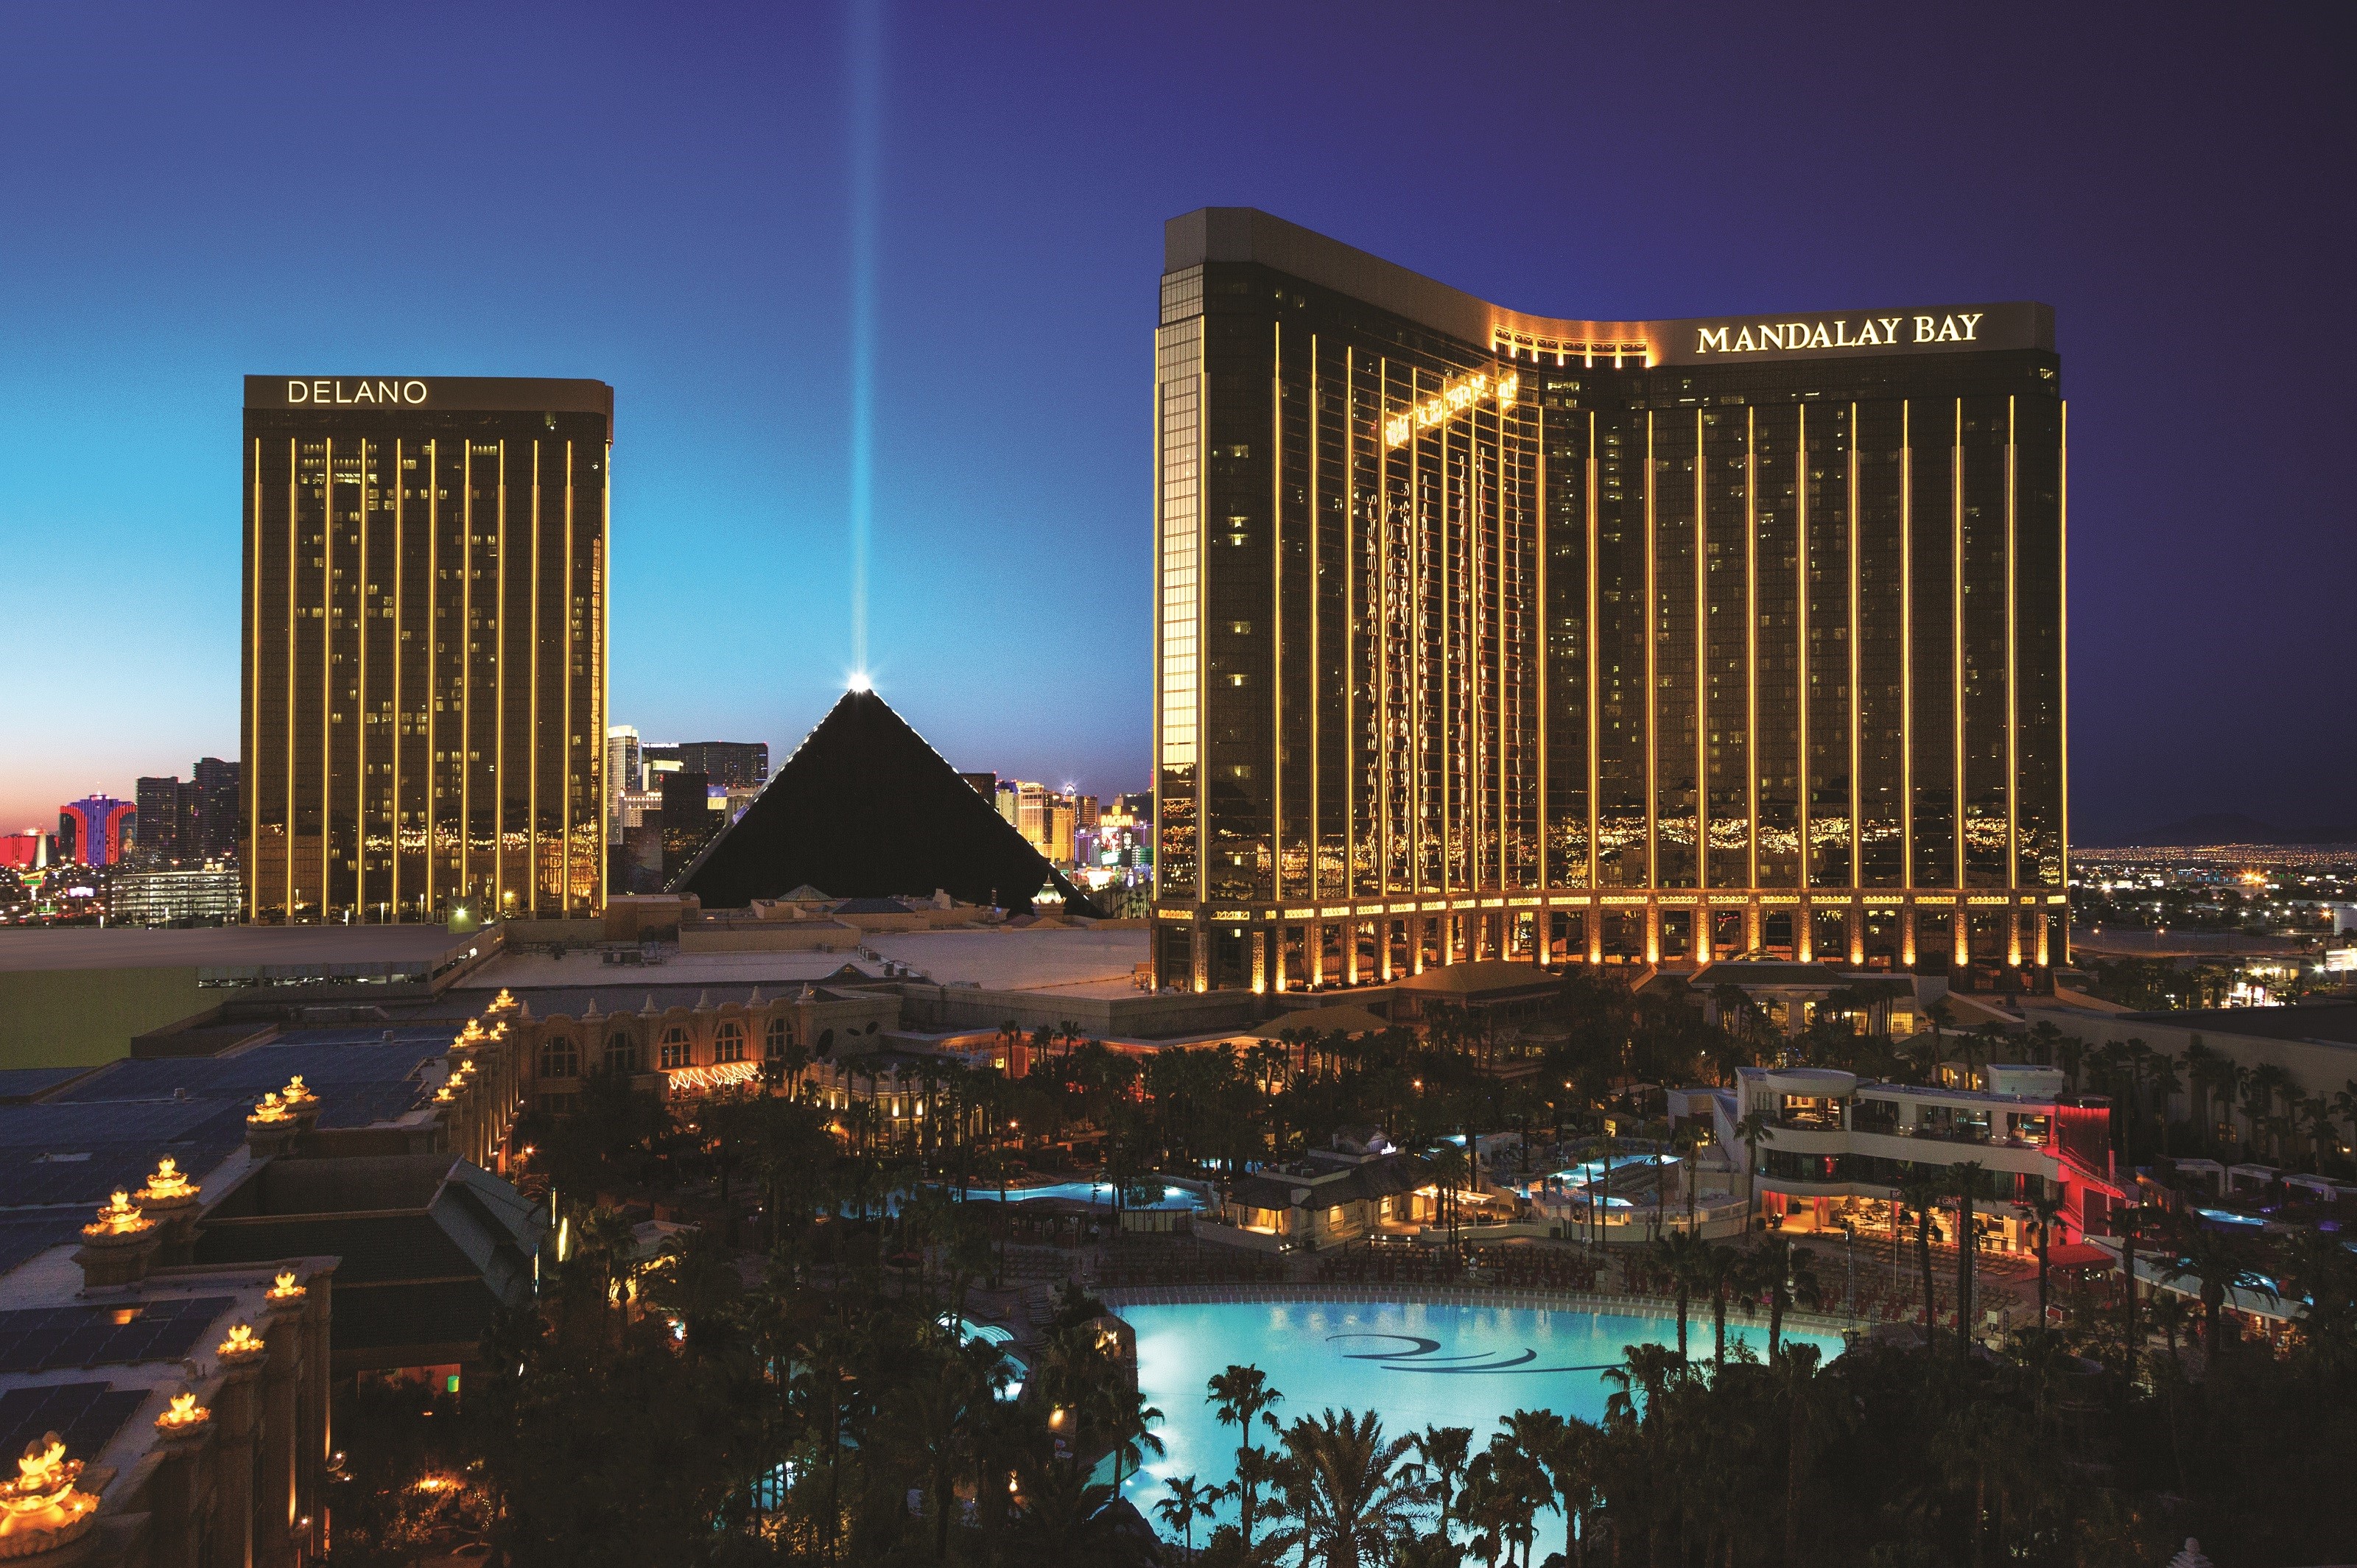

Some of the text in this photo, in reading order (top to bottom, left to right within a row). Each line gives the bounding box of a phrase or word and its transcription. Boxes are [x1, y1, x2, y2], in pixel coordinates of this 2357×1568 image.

[1696, 313, 1984, 354] MANDALAY BAY
[287, 380, 427, 404] DELANO
[1100, 815, 1134, 826] MGM
